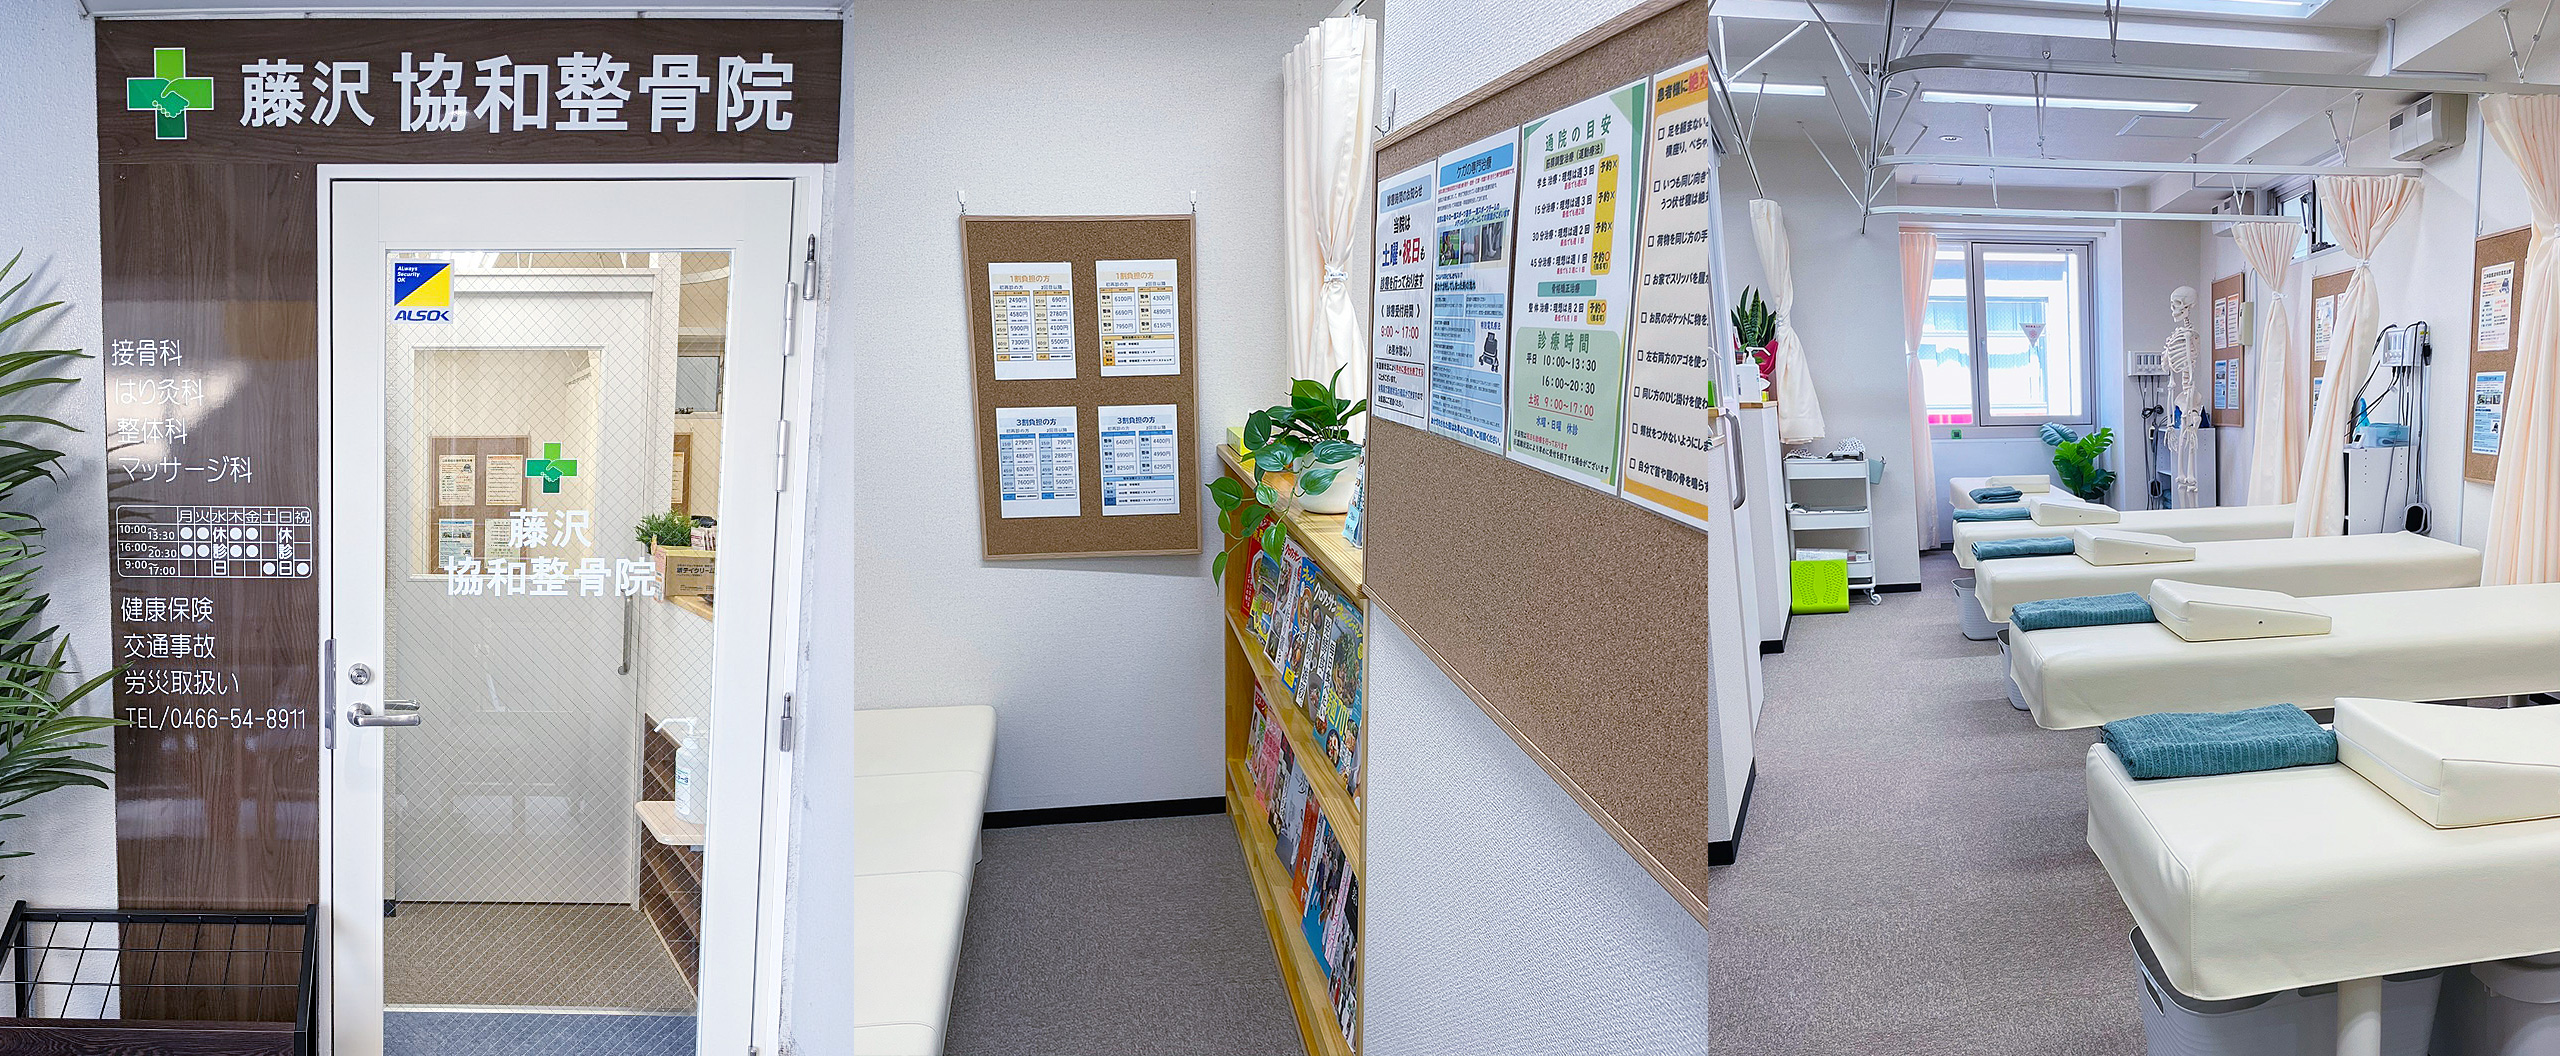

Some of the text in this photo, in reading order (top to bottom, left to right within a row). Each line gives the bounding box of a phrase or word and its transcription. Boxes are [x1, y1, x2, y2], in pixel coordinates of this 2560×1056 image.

[240, 51, 795, 132] 藤沢 協和整骨院
[1545, 114, 1612, 152] 通院の目安
[1663, 171, 1708, 190] いつも同じ向き
[1393, 214, 1411, 234] 当院は
[1656, 229, 1708, 247] 荷物を同じ方の手
[1382, 237, 1425, 267] 土曜・祝日も
[1380, 273, 1424, 290] 診療を行っております
[394, 310, 450, 321] ALSOK
[1649, 312, 1708, 326] お尻のポケットに物を
[111, 339, 183, 367] 接骨科
[1537, 330, 1590, 354] 診療時間
[1526, 352, 1537, 365] 平日
[1646, 350, 1708, 368] 左右両方のアゴを使っ
[115, 378, 204, 406] はり灸科
[1528, 393, 1540, 406] 土祝
[117, 417, 188, 445] 整体科
[1535, 416, 1579, 436] 水曜・日曜 休診
[118, 456, 253, 484] マッサージ科
[178, 509, 310, 524] 月 火 水 木 金 土 日 祝
[508, 508, 592, 548] 藤沢
[444, 555, 656, 598] 協和整骨院
[121, 596, 215, 623] 健康保険
[123, 633, 216, 659] 交通事故
[124, 669, 239, 696] 労災取扱い
[126, 707, 306, 731] TEL/0466-54-8911
